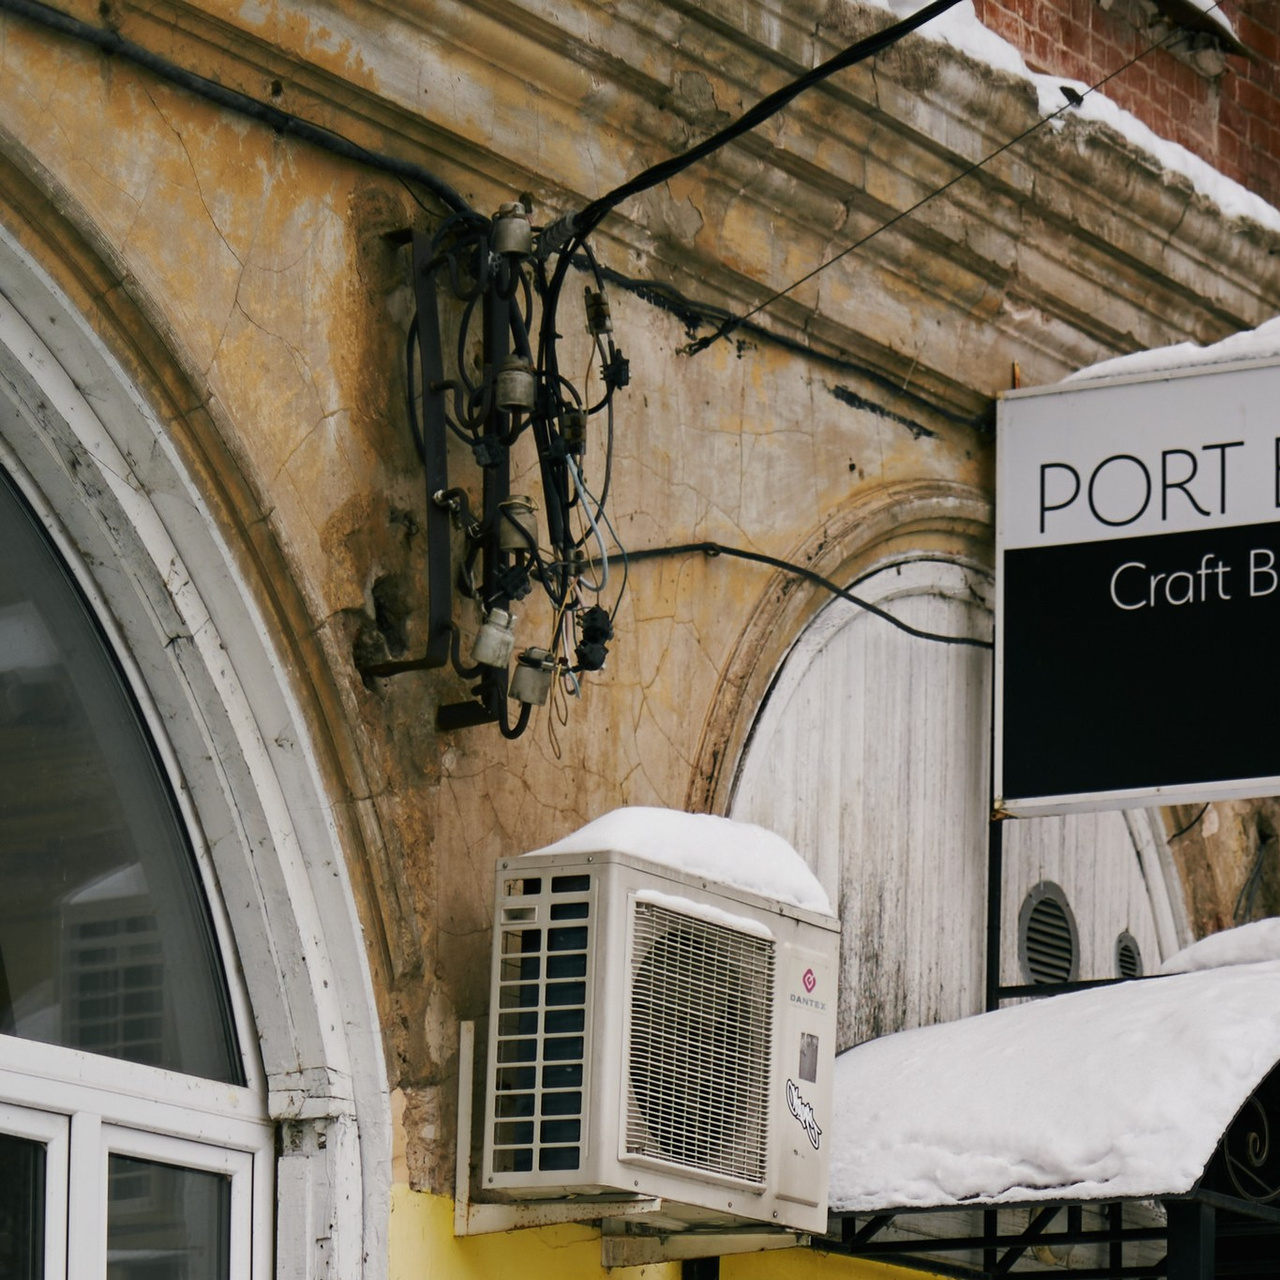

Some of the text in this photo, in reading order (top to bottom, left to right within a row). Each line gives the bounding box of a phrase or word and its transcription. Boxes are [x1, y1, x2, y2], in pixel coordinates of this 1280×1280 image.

[1039, 440, 1245, 534] PORT
[1110, 553, 1231, 611] Craft
[790, 993, 827, 1011] DANTEX
